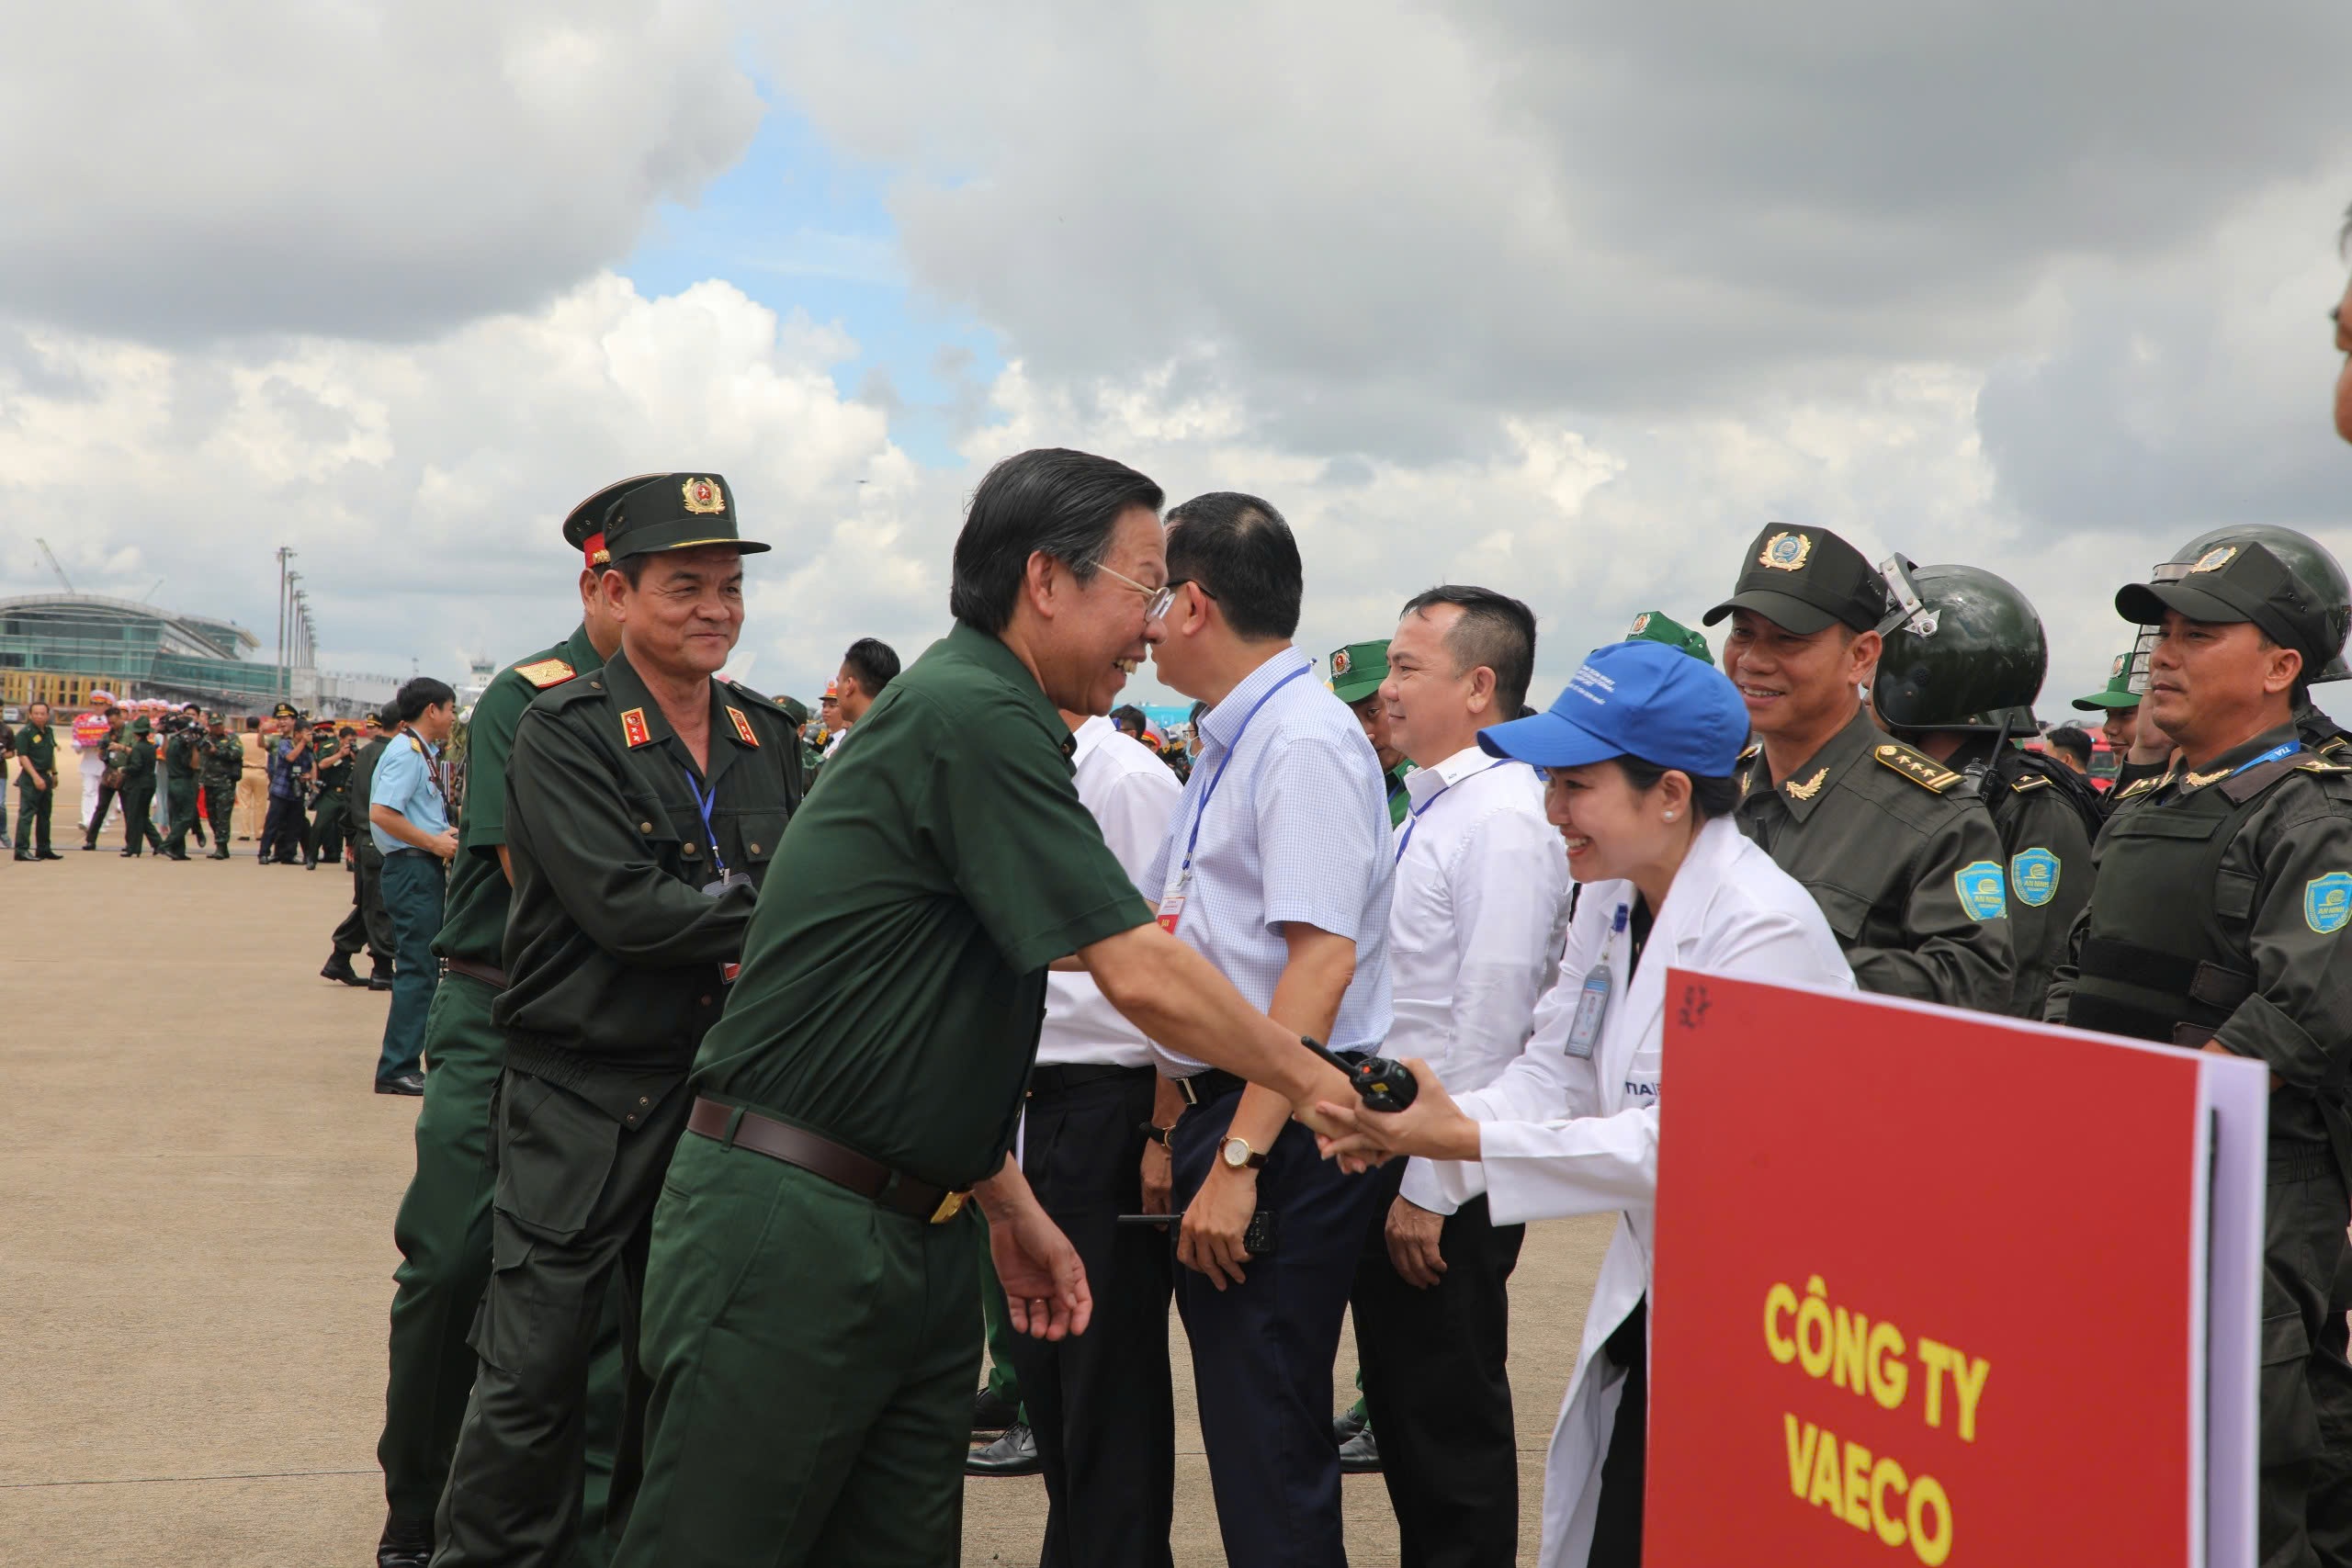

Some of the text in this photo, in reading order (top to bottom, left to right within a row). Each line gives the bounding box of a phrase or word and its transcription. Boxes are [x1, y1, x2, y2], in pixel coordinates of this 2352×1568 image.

[2274, 746, 2291, 757] TIA
[1764, 1275, 1991, 1442] CÔNG TY
[1784, 1413, 1953, 1567] VAECO
